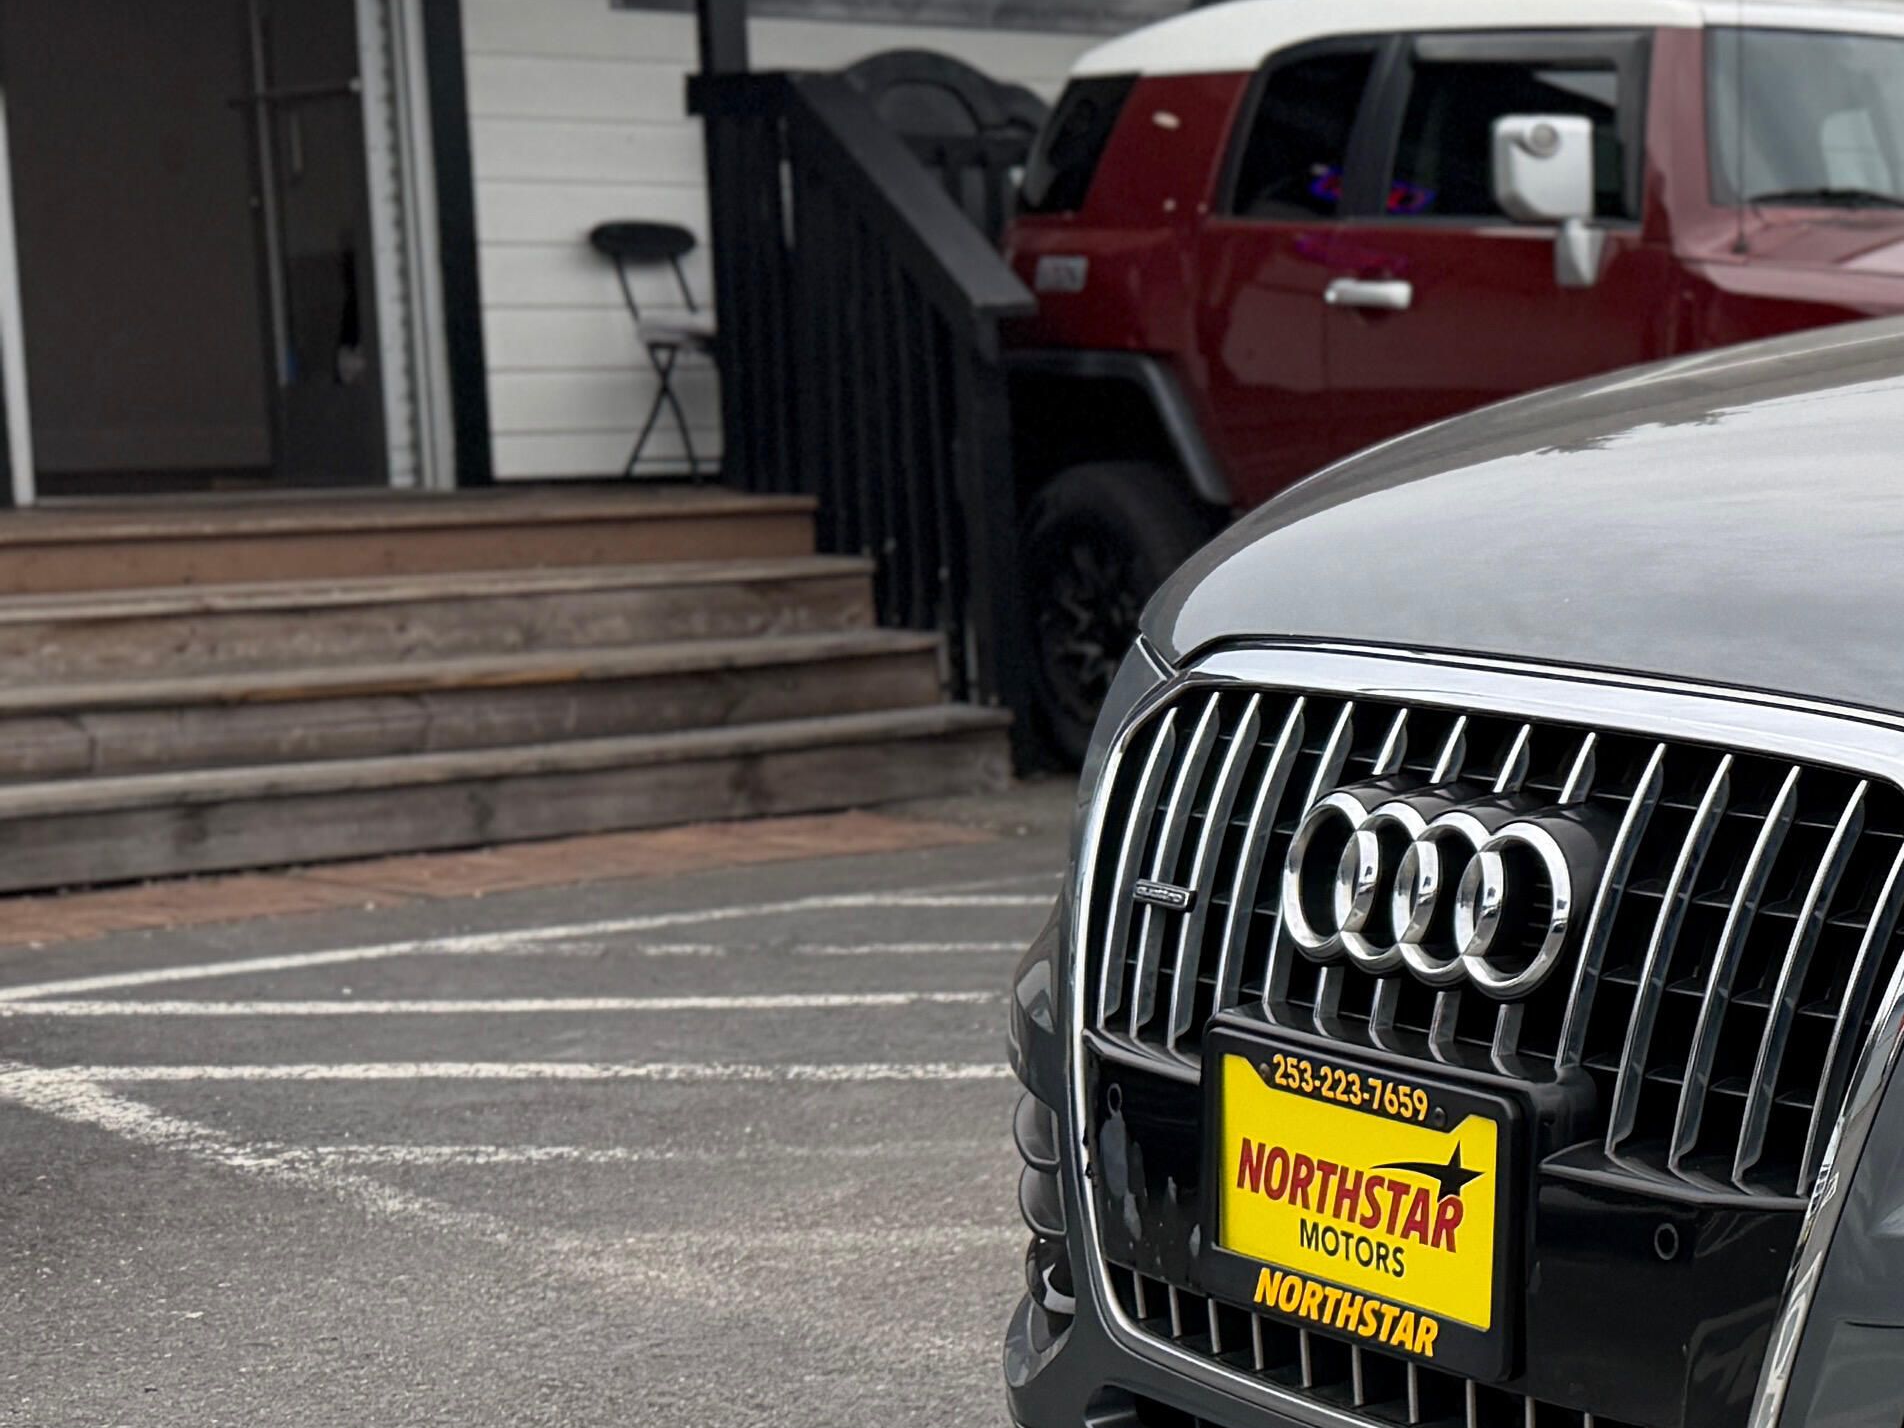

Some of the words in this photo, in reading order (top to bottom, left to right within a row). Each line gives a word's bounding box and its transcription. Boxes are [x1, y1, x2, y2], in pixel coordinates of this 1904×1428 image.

[1273, 1053, 1429, 1121] 253-223-7659
[1236, 1136, 1465, 1254] NORTHSTAR
[1299, 1217, 1406, 1278] MOTORS
[1253, 1266, 1439, 1358] NORTHSTAR
